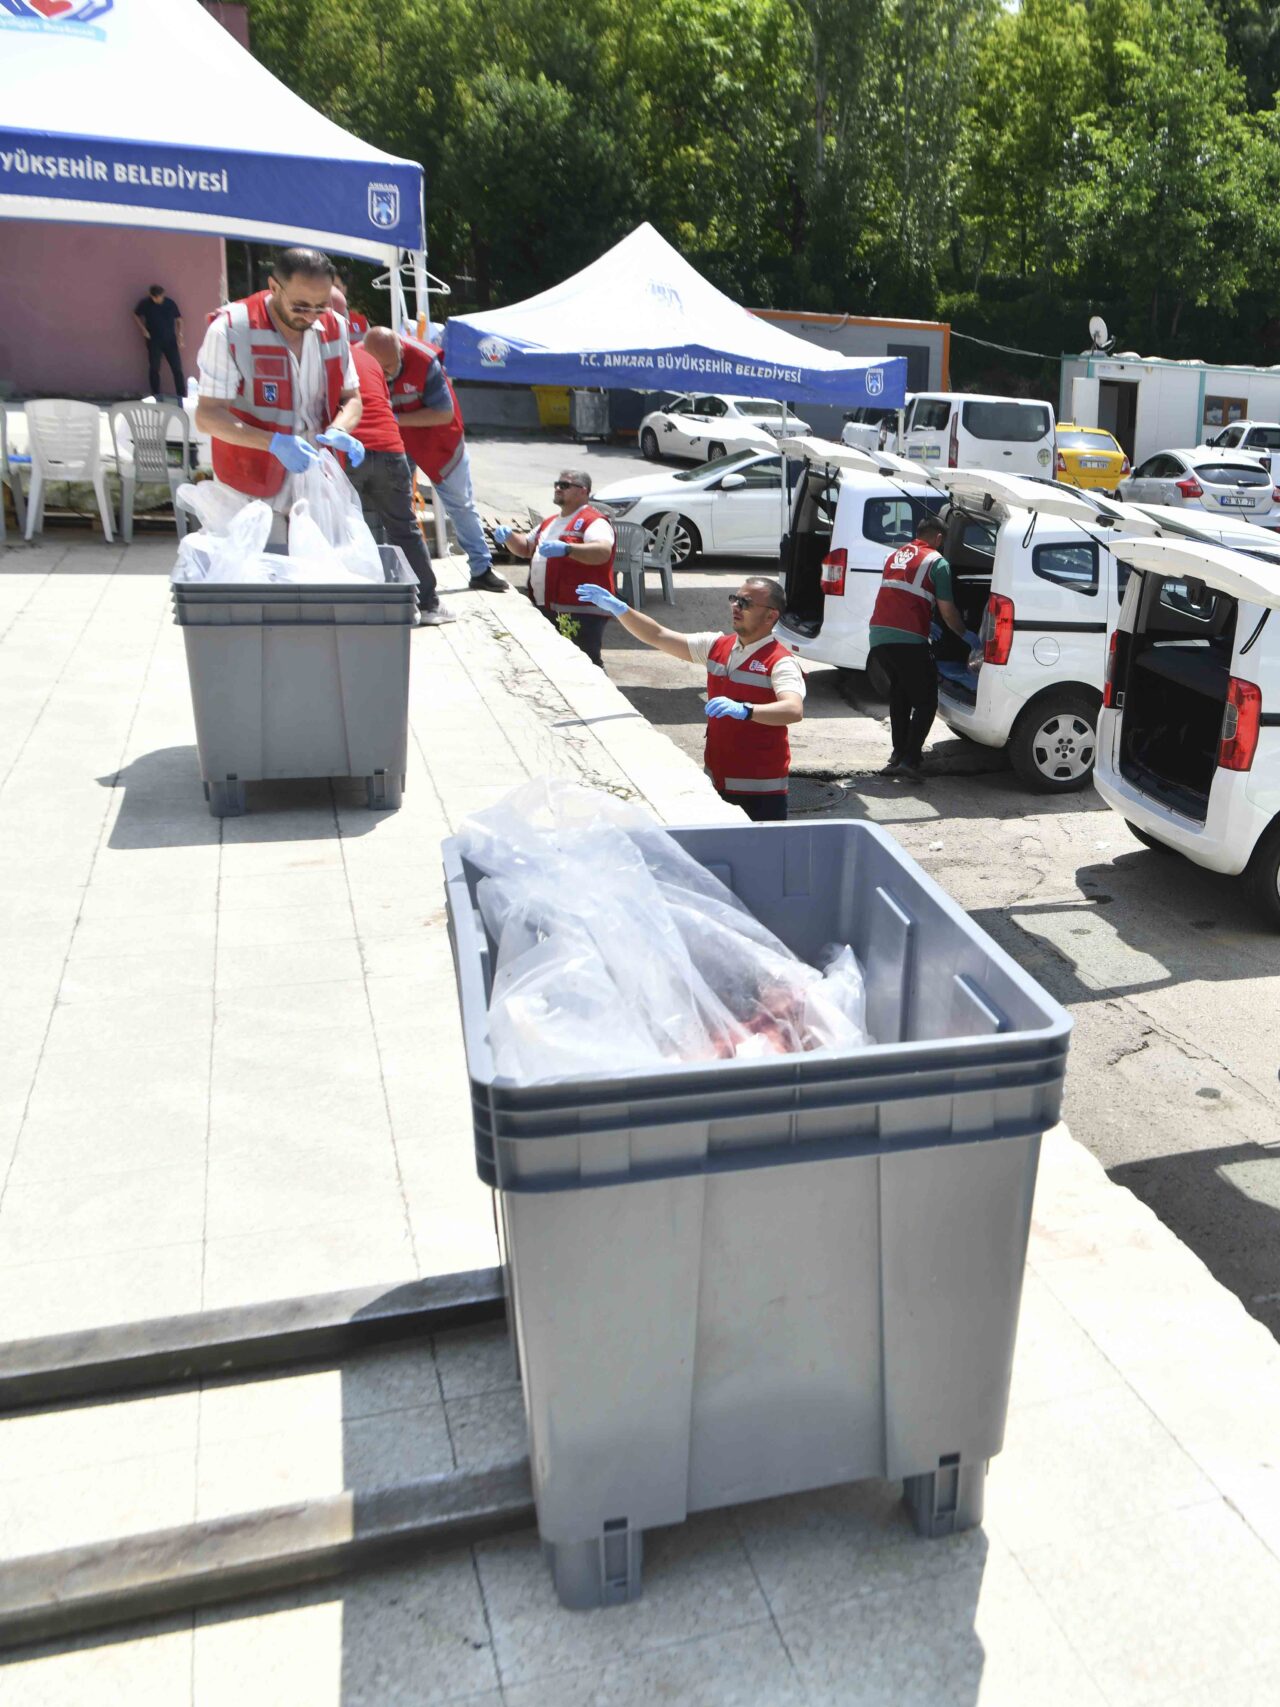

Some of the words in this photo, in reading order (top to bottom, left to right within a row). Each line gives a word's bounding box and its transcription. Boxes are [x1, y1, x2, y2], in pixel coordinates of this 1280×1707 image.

[113, 162, 229, 193] BELEDİYESİ
[579, 353, 600, 367] T.C.
[604, 354, 654, 369] ANKARA
[657, 353, 732, 374] BÜYÜKŞEHİR
[736, 364, 801, 384] BELEDİYESİ
